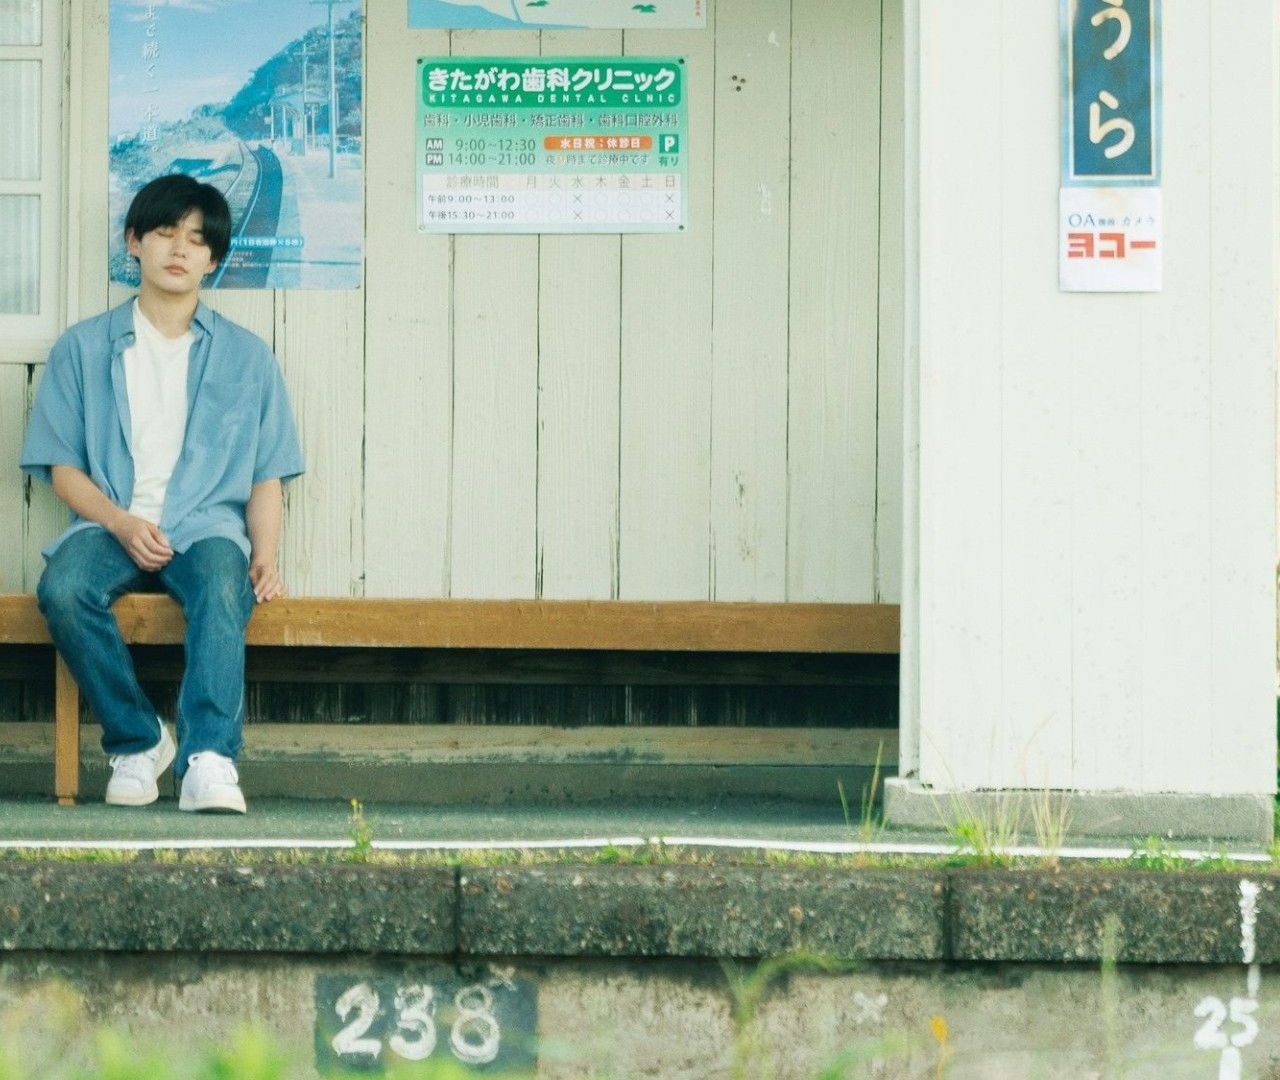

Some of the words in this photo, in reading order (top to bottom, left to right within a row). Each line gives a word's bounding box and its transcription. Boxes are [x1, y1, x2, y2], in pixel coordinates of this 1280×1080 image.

[428, 66, 676, 92] きたがわ歯科クリニック
[429, 94, 522, 103] KITAGAWA
[537, 94, 607, 103] DENTAL
[426, 139, 443, 151] AM
[664, 136, 675, 152] P
[426, 153, 443, 165] PM
[526, 175, 537, 189] 月
[665, 175, 675, 188] 日
[1068, 233, 1156, 258] ヨコー
[1193, 995, 1260, 1049] 25
